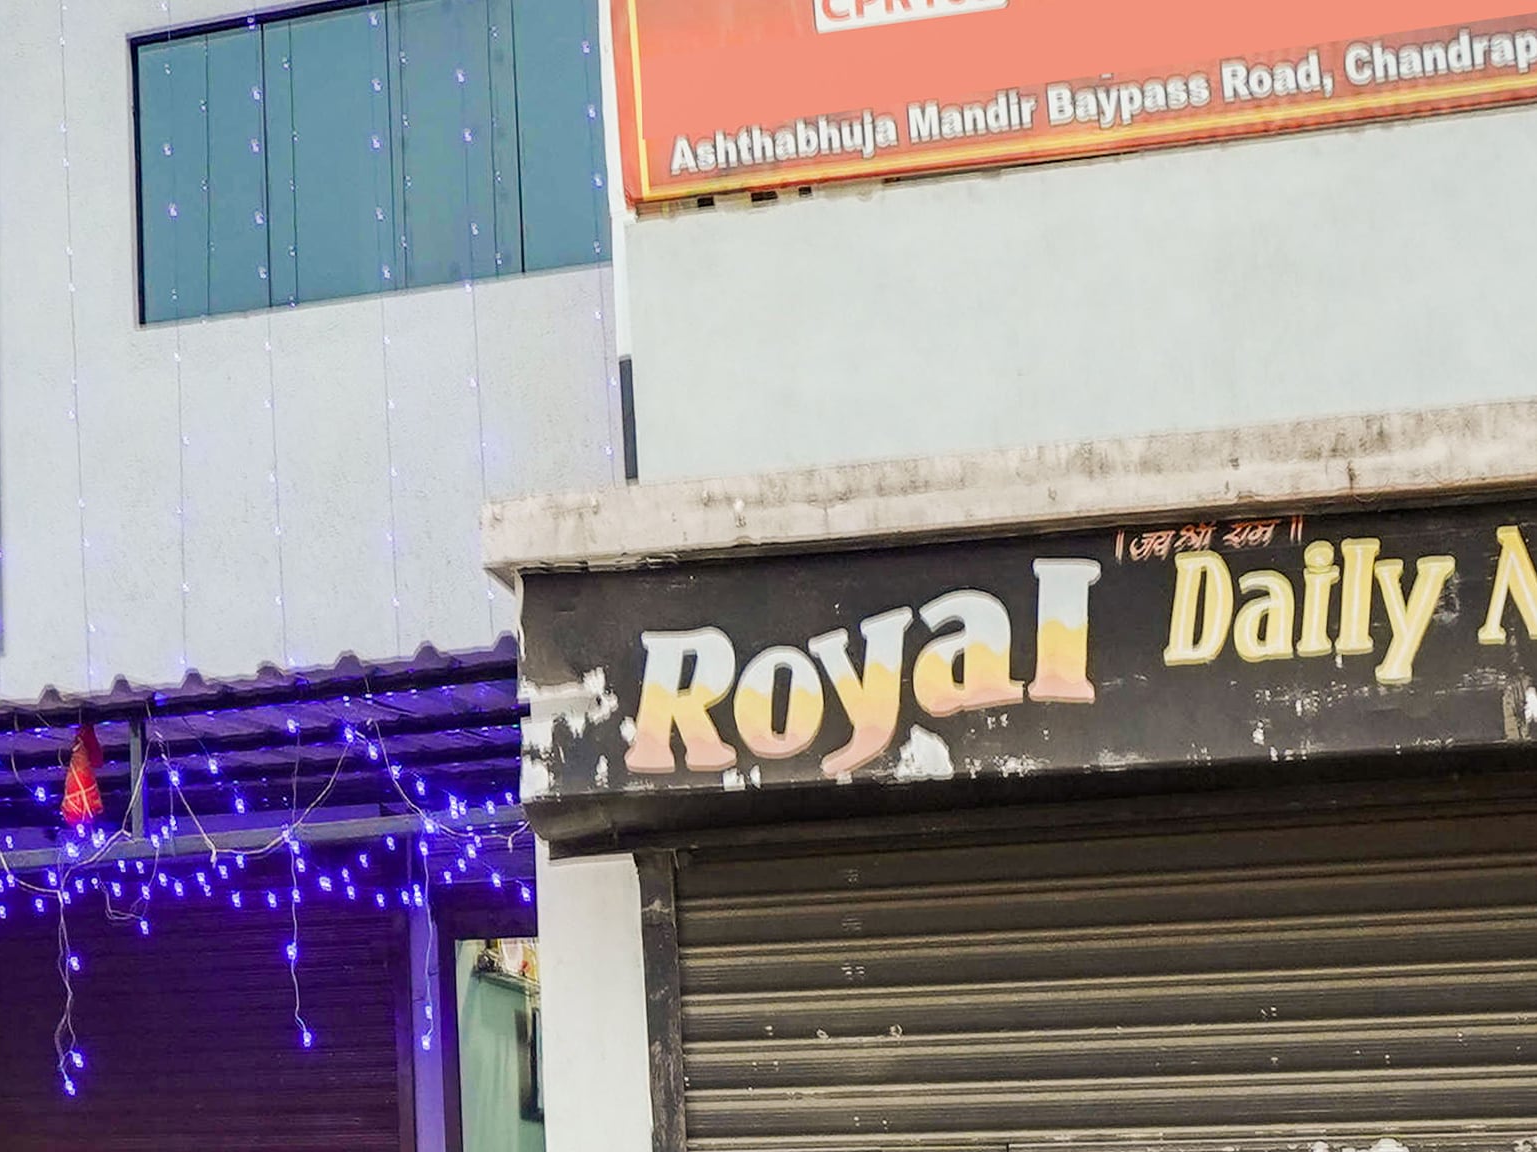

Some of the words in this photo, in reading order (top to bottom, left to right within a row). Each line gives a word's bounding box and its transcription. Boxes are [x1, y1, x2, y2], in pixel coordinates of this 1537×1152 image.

[670, 109, 898, 175] Ashthabhuja
[907, 87, 1037, 144] Mandir
[1046, 73, 1211, 128] Baypass
[1220, 48, 1333, 98] Road,
[625, 557, 1102, 777] Royal
[1163, 537, 1456, 683] Daily
